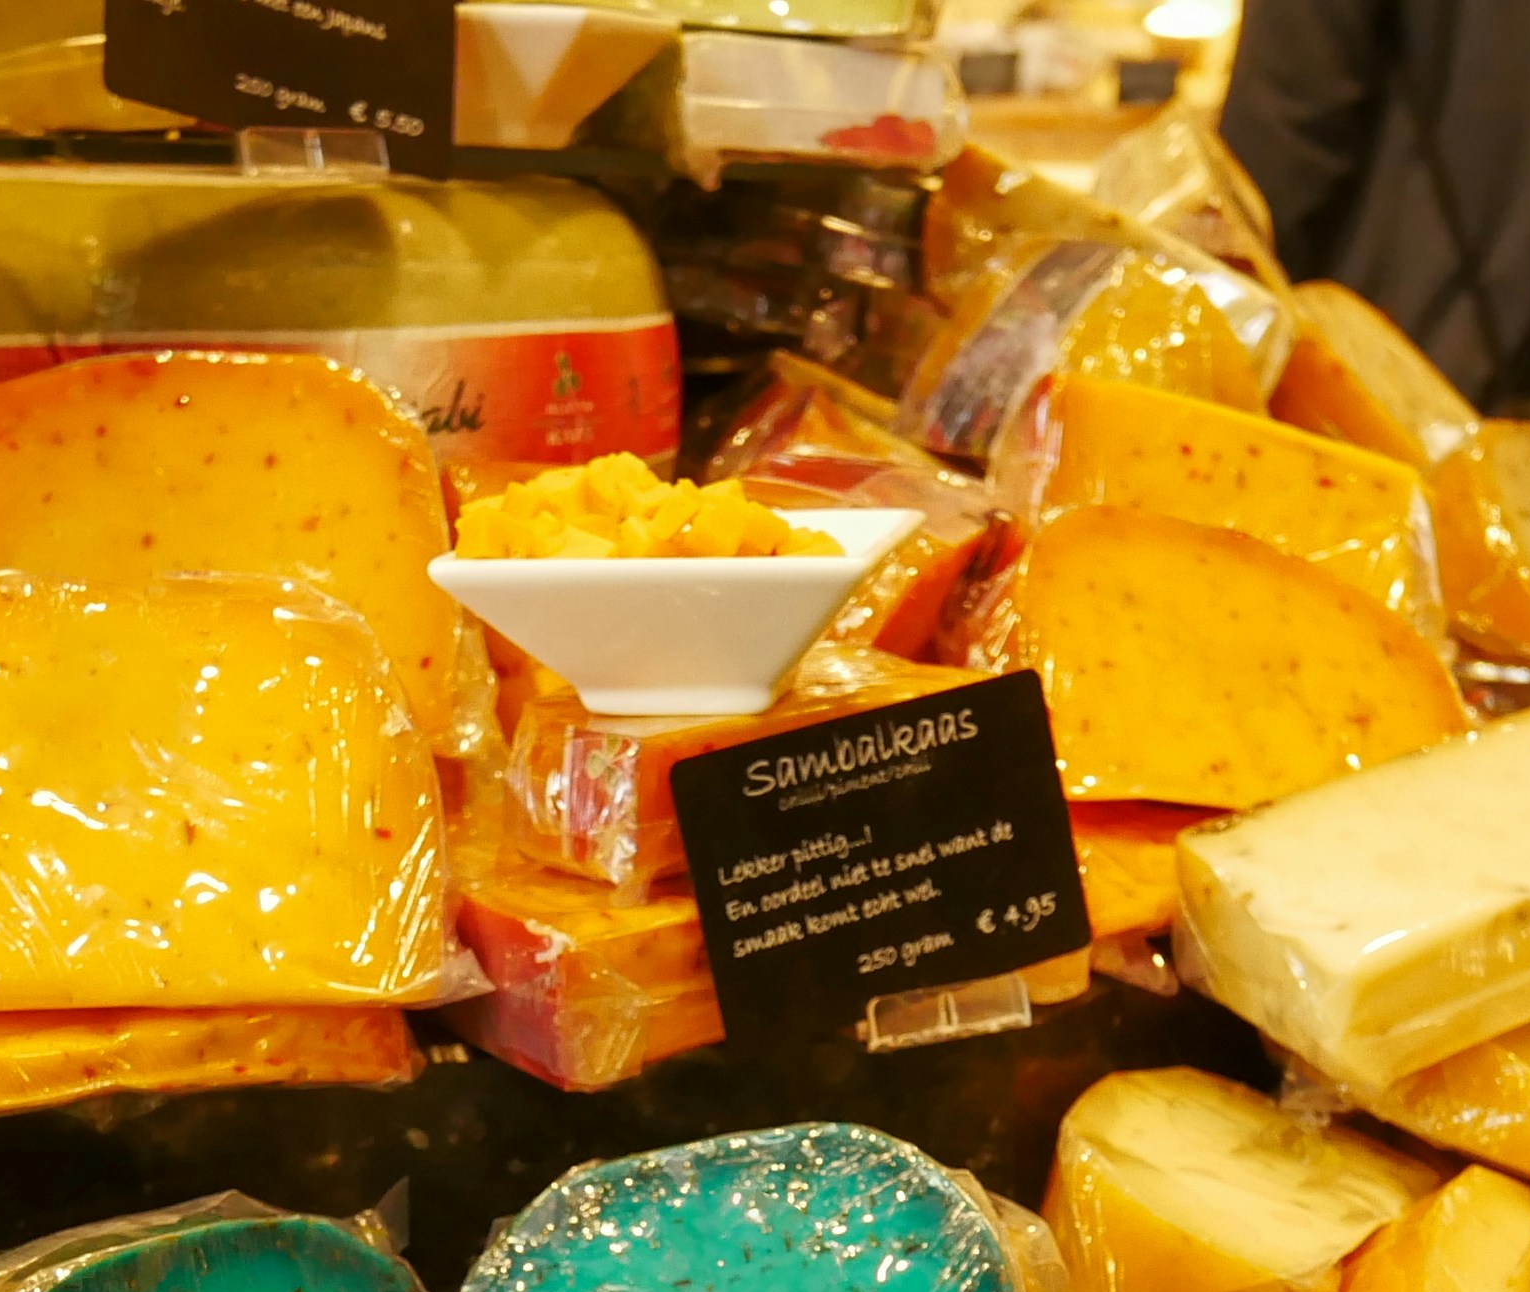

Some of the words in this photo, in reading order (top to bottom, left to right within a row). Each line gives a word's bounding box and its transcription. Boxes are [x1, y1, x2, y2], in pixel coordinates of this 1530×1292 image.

[274, 86, 327, 111] gram
[349, 100, 368, 123] €
[743, 708, 979, 797] Sambalkaas
[717, 853, 789, 887] Lekker
[725, 899, 758, 922] En
[760, 873, 827, 913] oordeel
[829, 862, 870, 890] niet
[871, 857, 892, 878] te
[894, 841, 937, 872] snel
[937, 827, 989, 857] want
[990, 819, 1015, 843] de
[733, 920, 805, 958] smaak
[804, 902, 861, 935] komt
[861, 889, 904, 919] echt
[856, 945, 898, 974] 250
[900, 932, 955, 968] gram
[975, 907, 997, 934] €
[1003, 890, 1057, 932] 4.95
